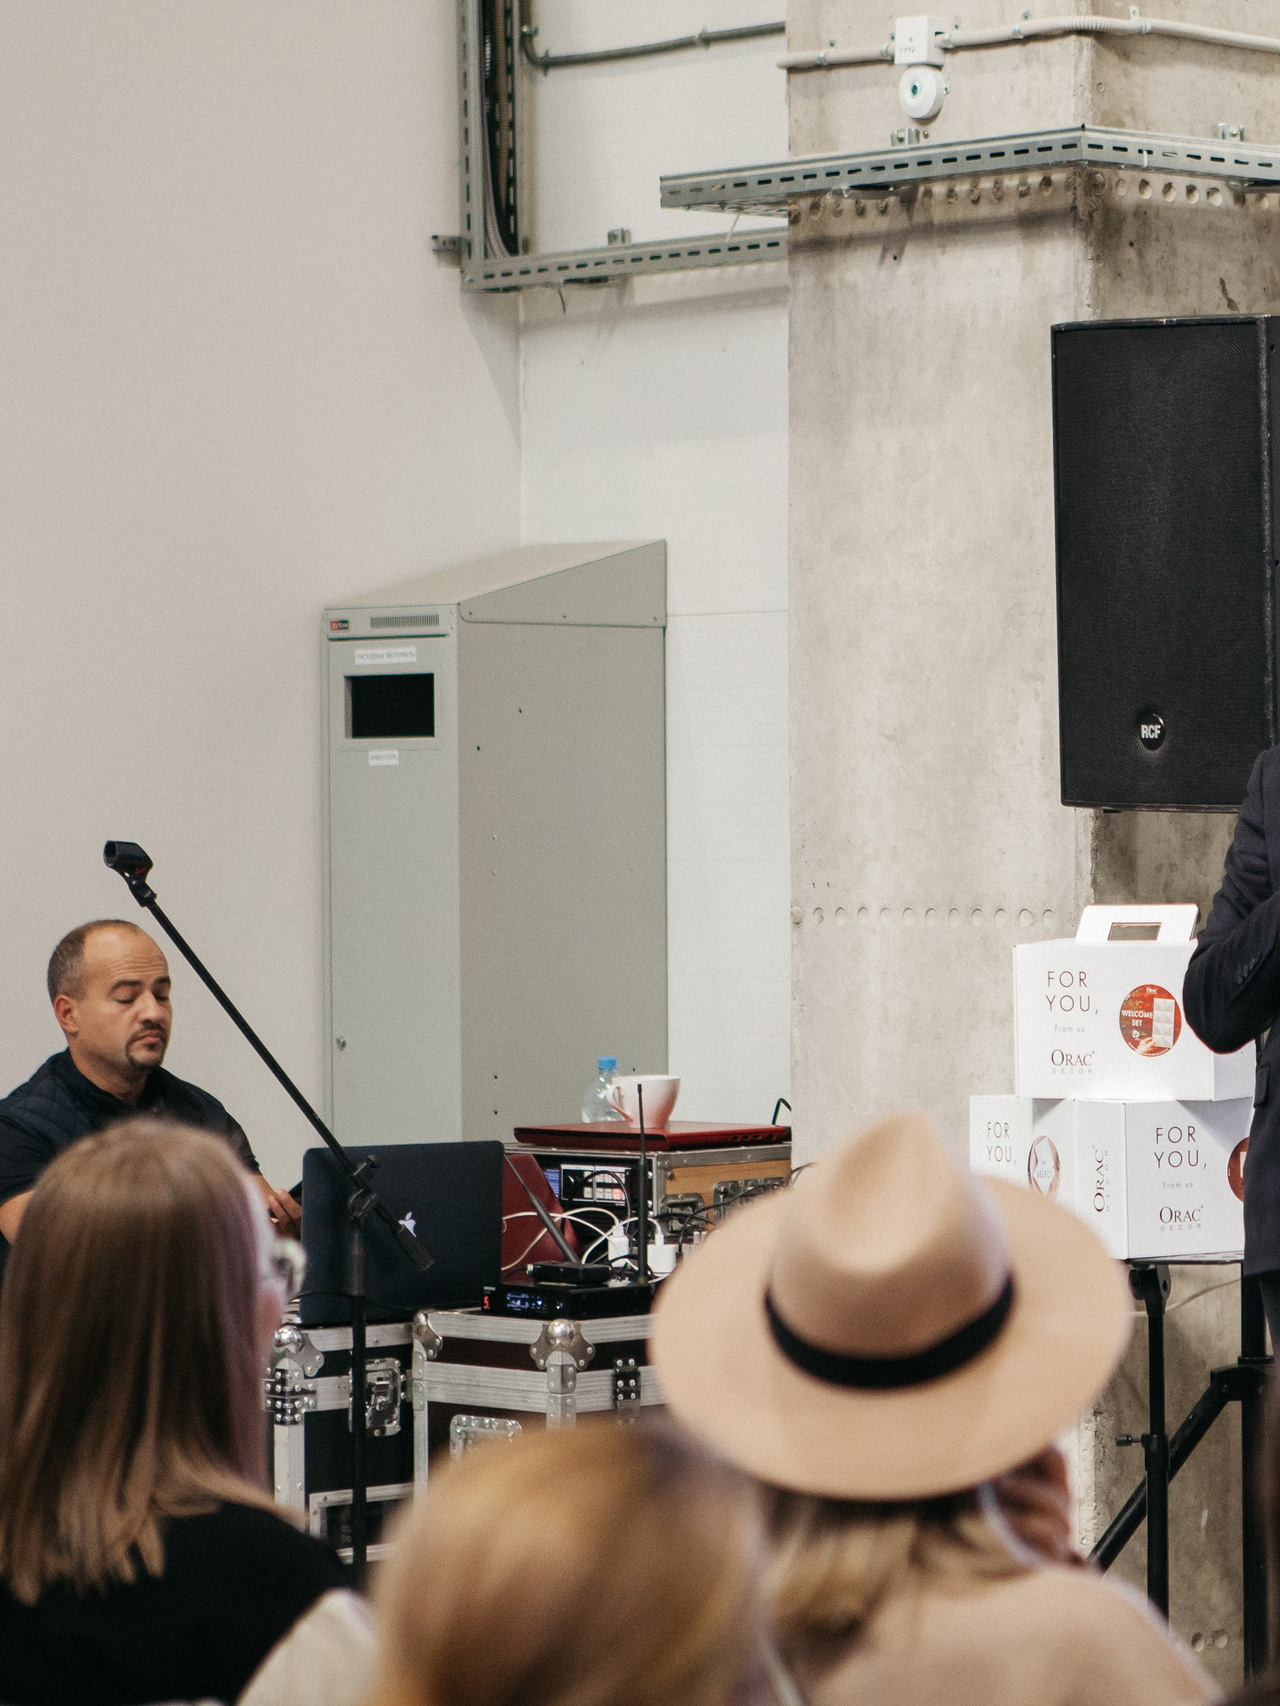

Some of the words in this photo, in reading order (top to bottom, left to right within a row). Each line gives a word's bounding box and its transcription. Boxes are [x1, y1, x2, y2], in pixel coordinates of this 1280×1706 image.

[1141, 725, 1161, 739] RCF
[1047, 971, 1087, 988] FOR
[1046, 994, 1099, 1015] YOU,
[1121, 1009, 1154, 1019] WELCOME
[1131, 1019, 1143, 1027] SET
[1051, 1049, 1093, 1067] ORAC
[987, 1121, 1010, 1139] FOR
[1156, 1125, 1196, 1144] FOR
[986, 1145, 1017, 1166] YOU,
[1153, 1149, 1207, 1169] YOU,
[1160, 1206, 1201, 1224] ORAC
[1160, 1223, 1202, 1232] DECOR
